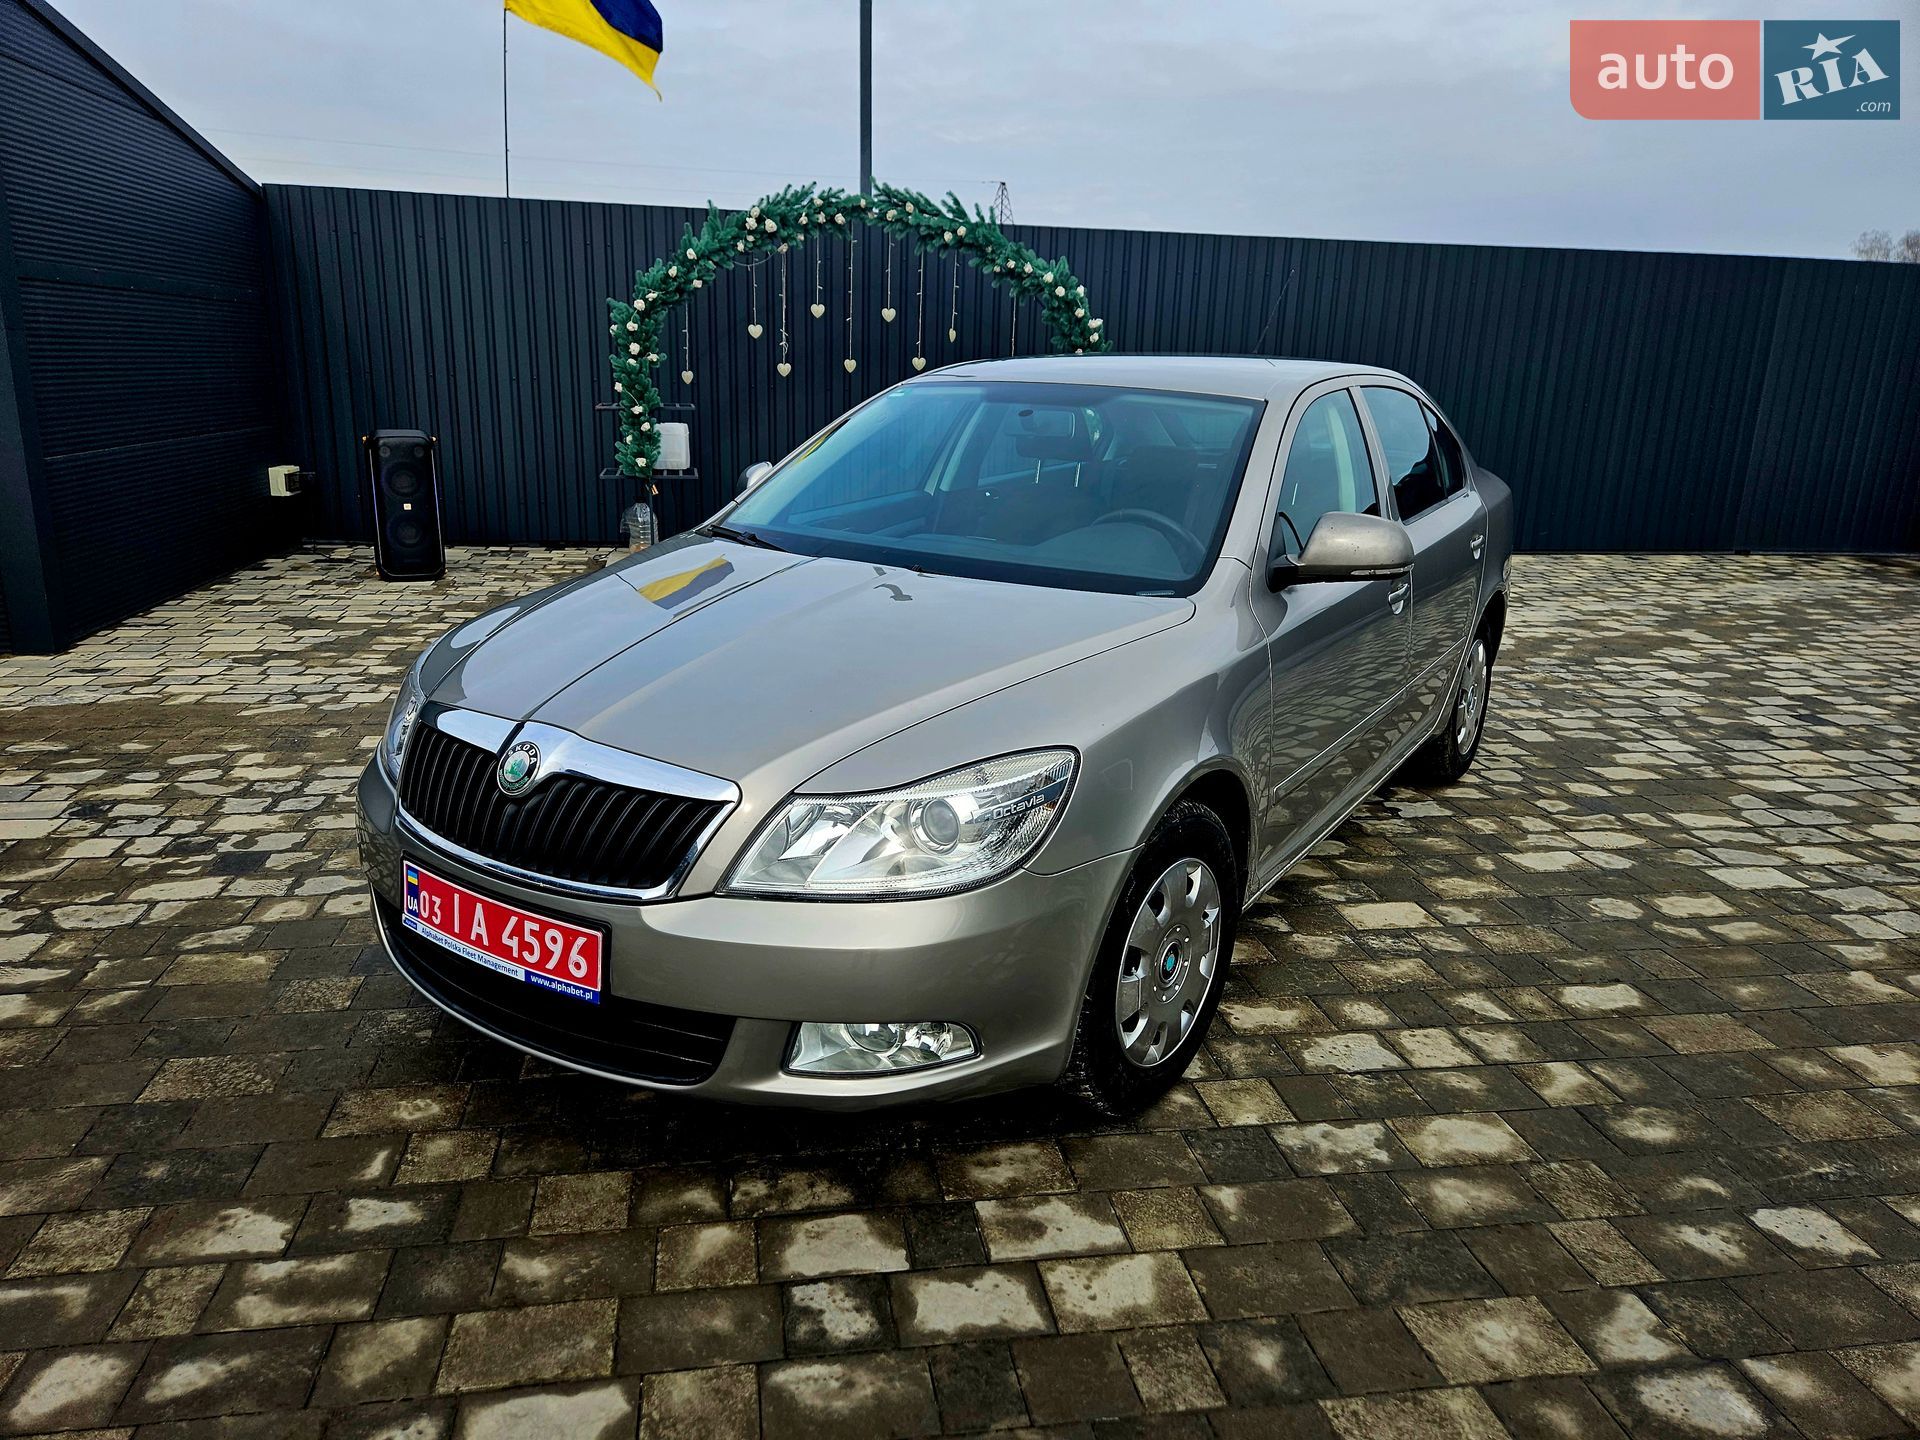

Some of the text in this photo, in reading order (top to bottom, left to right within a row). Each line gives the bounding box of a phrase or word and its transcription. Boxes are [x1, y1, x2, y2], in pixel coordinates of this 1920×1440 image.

[407, 895, 419, 913] UA
[420, 890, 441, 925] 03
[501, 915, 588, 978] 4596
[421, 927, 519, 977] Alphabet Polska Fleet Management
[530, 975, 593, 1000] www.alphabet.pl
